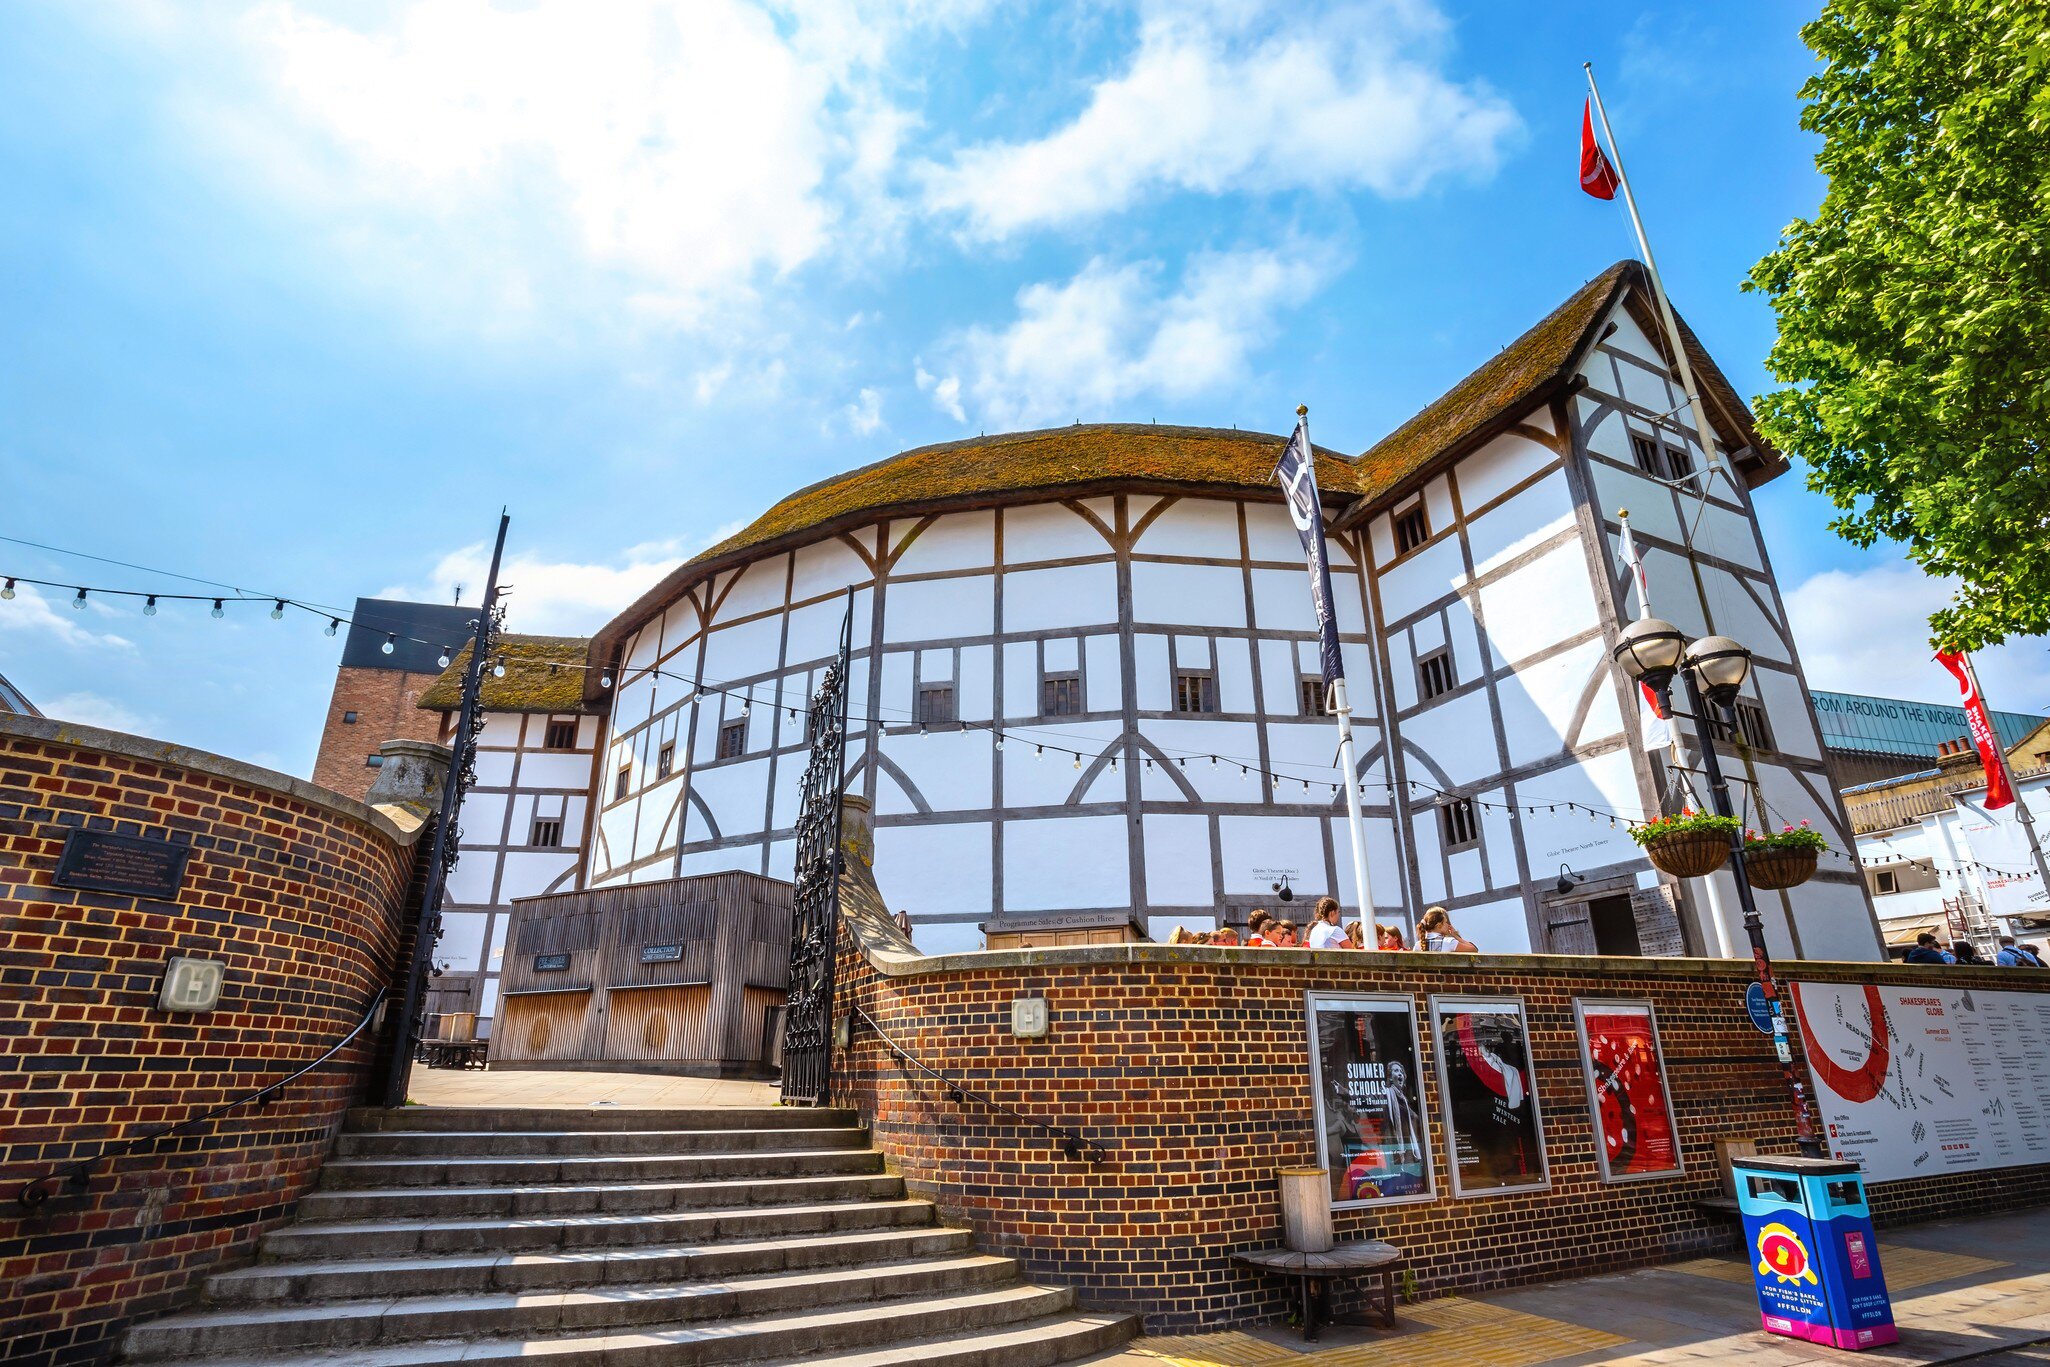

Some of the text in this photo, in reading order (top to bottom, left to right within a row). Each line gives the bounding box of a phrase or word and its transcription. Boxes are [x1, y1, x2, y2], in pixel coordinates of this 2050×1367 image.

[1811, 696, 1967, 727] ROM AROUND THE WORLD
[1966, 709, 1984, 743] GLOBE
[999, 920, 1037, 929] Programme
[1066, 916, 1095, 924] Cushion
[643, 946, 675, 954] COLLECTION
[1900, 997, 1941, 1007] SHAKESPEARE'S
[1926, 1008, 1944, 1016] GLOBE
[1845, 1021, 1872, 1043] READ NOT
[1347, 1063, 1385, 1079] SUMMER
[1597, 1058, 1626, 1094] Shakespeare
[1348, 1080, 1387, 1096] SCHOOLS
[1494, 1096, 1507, 1108] THE
[1492, 1113, 1507, 1125] TALE
[1495, 1106, 1521, 1125] WINTER'S
[1913, 1151, 1929, 1168] OTHELLO
[1778, 1288, 1798, 1297] FISH'S
